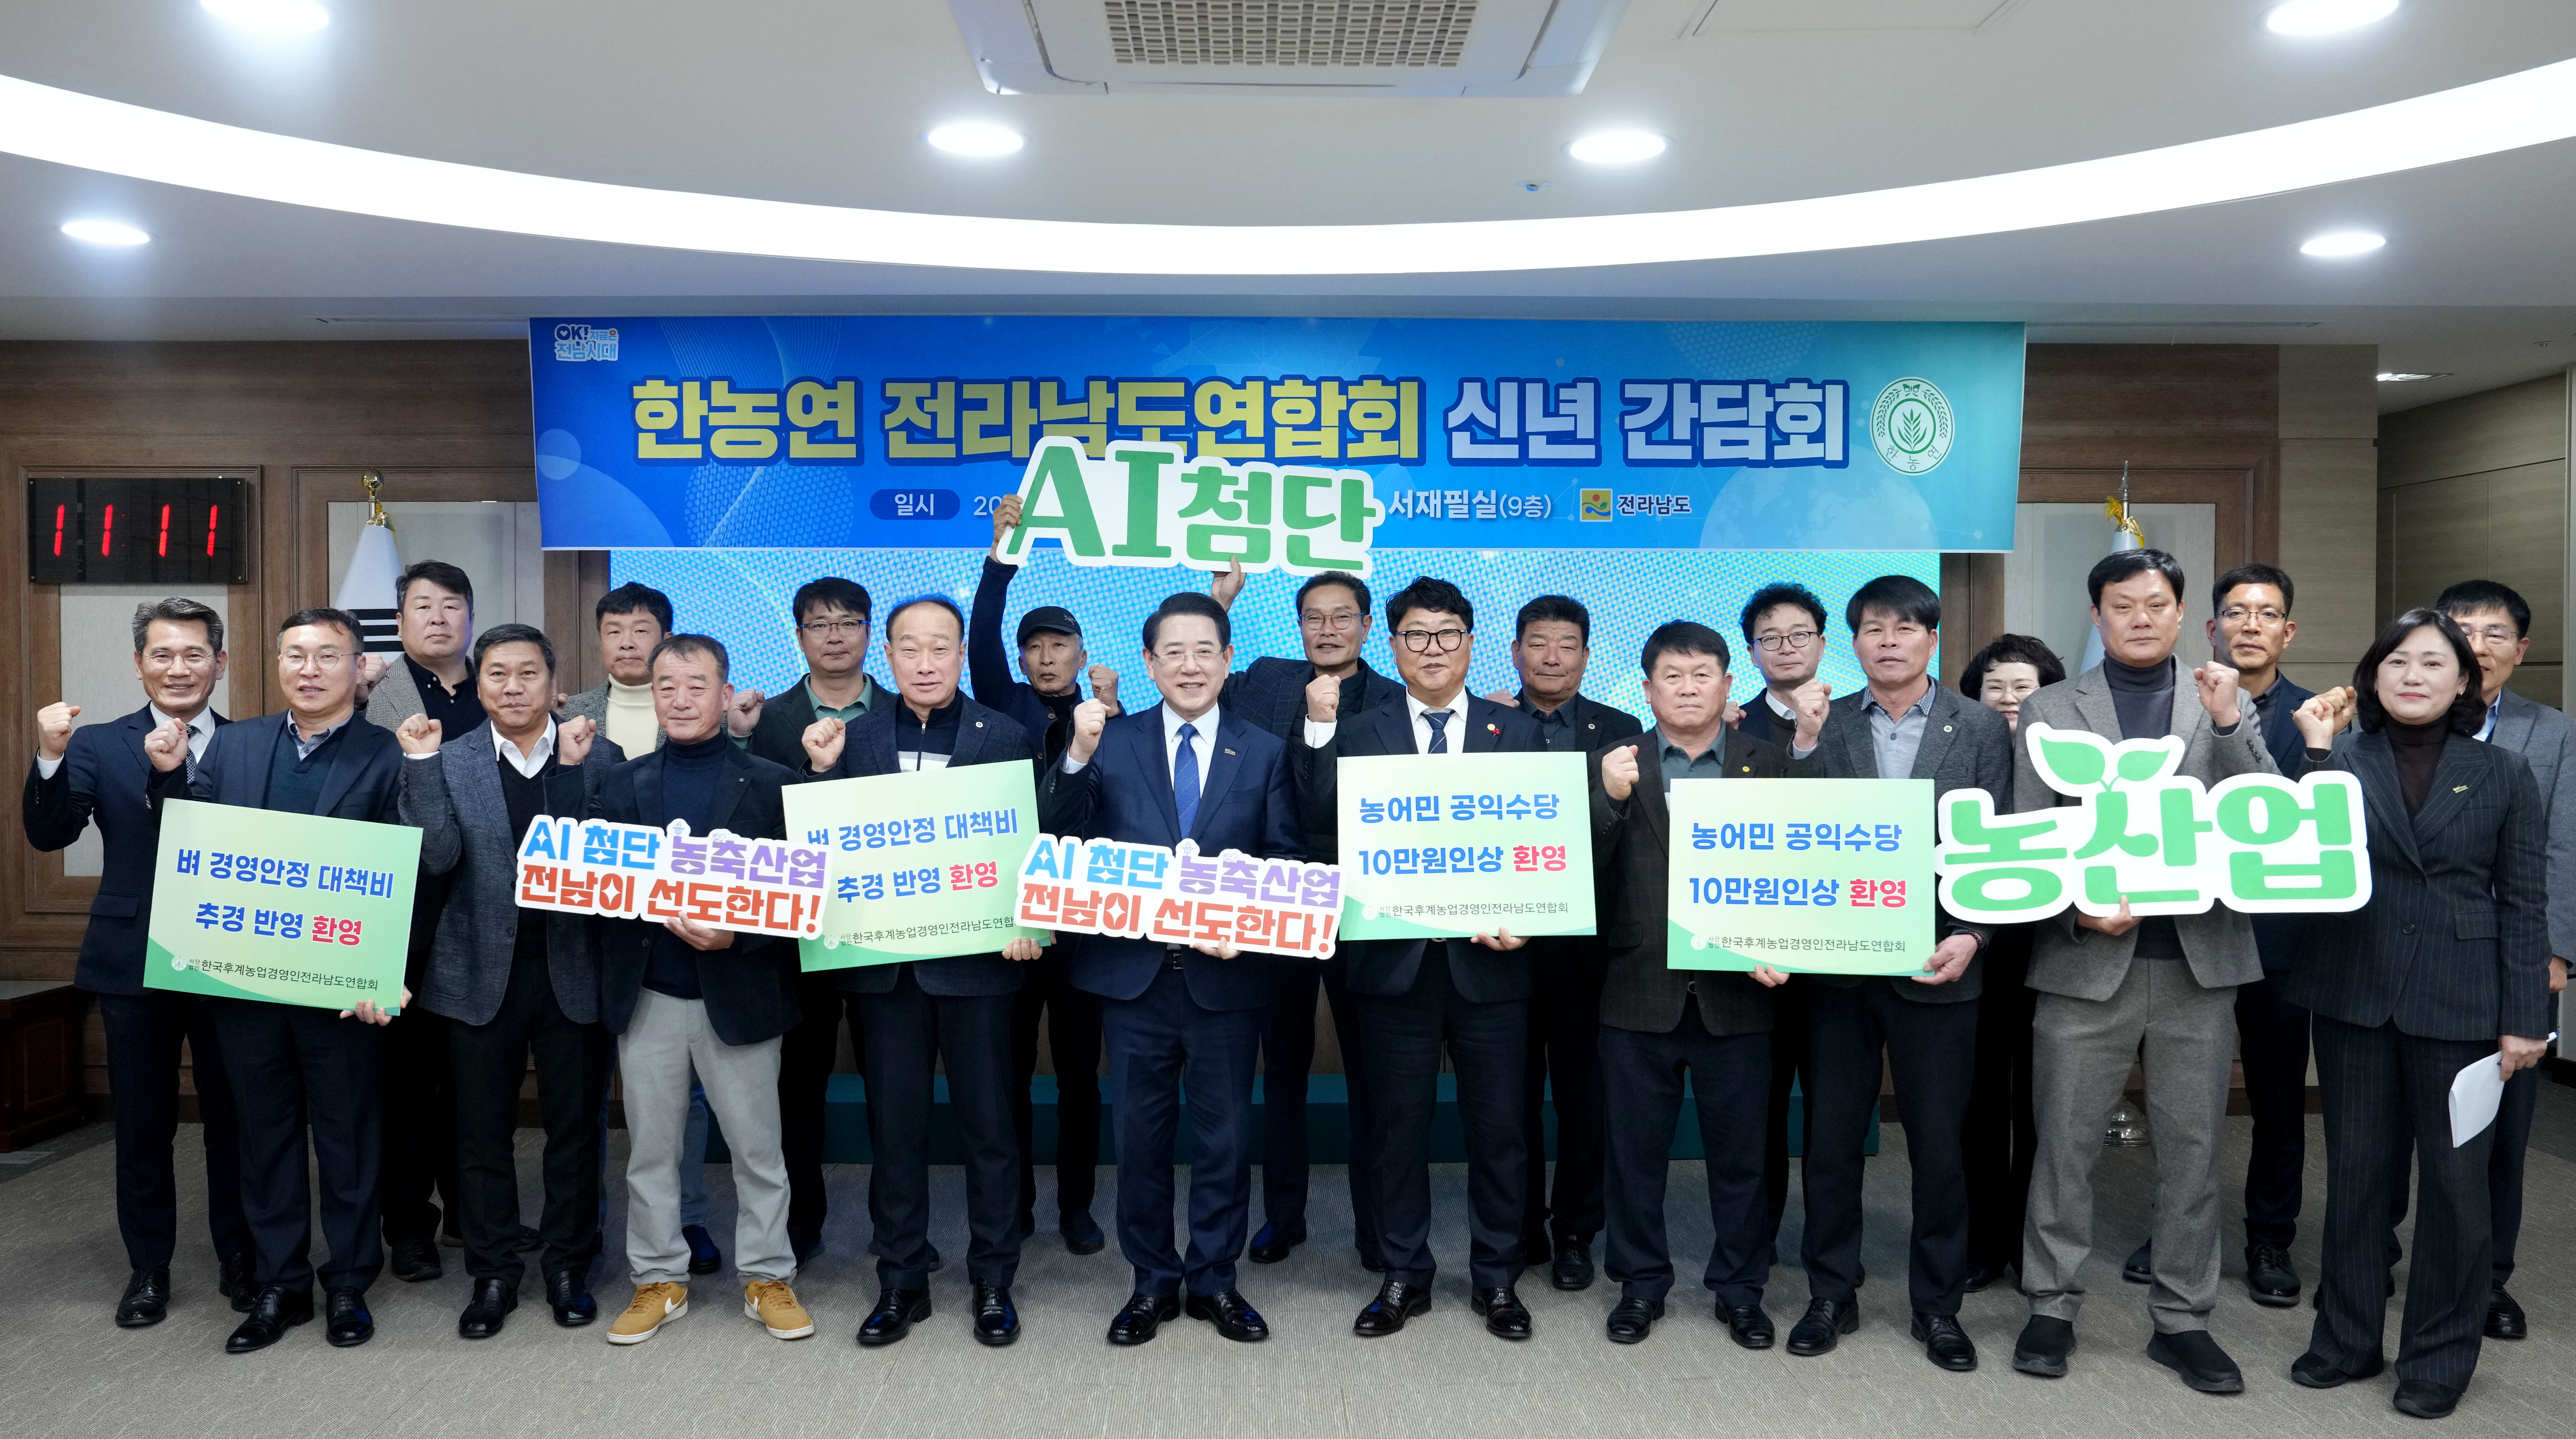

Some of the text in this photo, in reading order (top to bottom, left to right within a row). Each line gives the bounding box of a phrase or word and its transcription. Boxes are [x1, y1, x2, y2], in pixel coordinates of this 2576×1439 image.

[557, 326, 617, 340] OK! 지금은
[557, 343, 616, 359] 전남시대
[633, 380, 1843, 460] 한농연 전라남도연합회 신년 간담회
[894, 493, 934, 516] 일시
[1006, 446, 1376, 570] AI첨단
[1388, 489, 1551, 518] 서재필실(9층)
[1618, 496, 1690, 515] 전라남도
[1359, 794, 1559, 823] 농어민 공익수당
[839, 817, 936, 851] 경영안정
[945, 808, 1018, 840] 대책비
[1692, 823, 1902, 852] 농어민 공익수당
[524, 822, 827, 889] AI 첨단 농축산업
[1358, 845, 1567, 875] 10만원인상 환영
[1945, 783, 2357, 911] 농산업
[177, 849, 394, 898] 벼 경영안정 대책비
[837, 861, 998, 903] 추경 반영 환영
[1025, 840, 1340, 908] AI 첨단 농축산업
[522, 864, 821, 933] 전남이 선도한다!
[1689, 877, 1907, 908] 10만원인상 환영
[196, 903, 362, 946] 추경 반영 환영
[1021, 883, 1334, 953] 전남이 선도한다!
[1392, 902, 1568, 916] 한국후계농업경영인전라남도연합회
[852, 916, 1016, 944] 한국후계농업경영인전라남도연합
[1721, 936, 1905, 953] 한국후계농업경영인전라남도연합회
[201, 960, 379, 991] 한국후계농업경영인전라남도연합회
